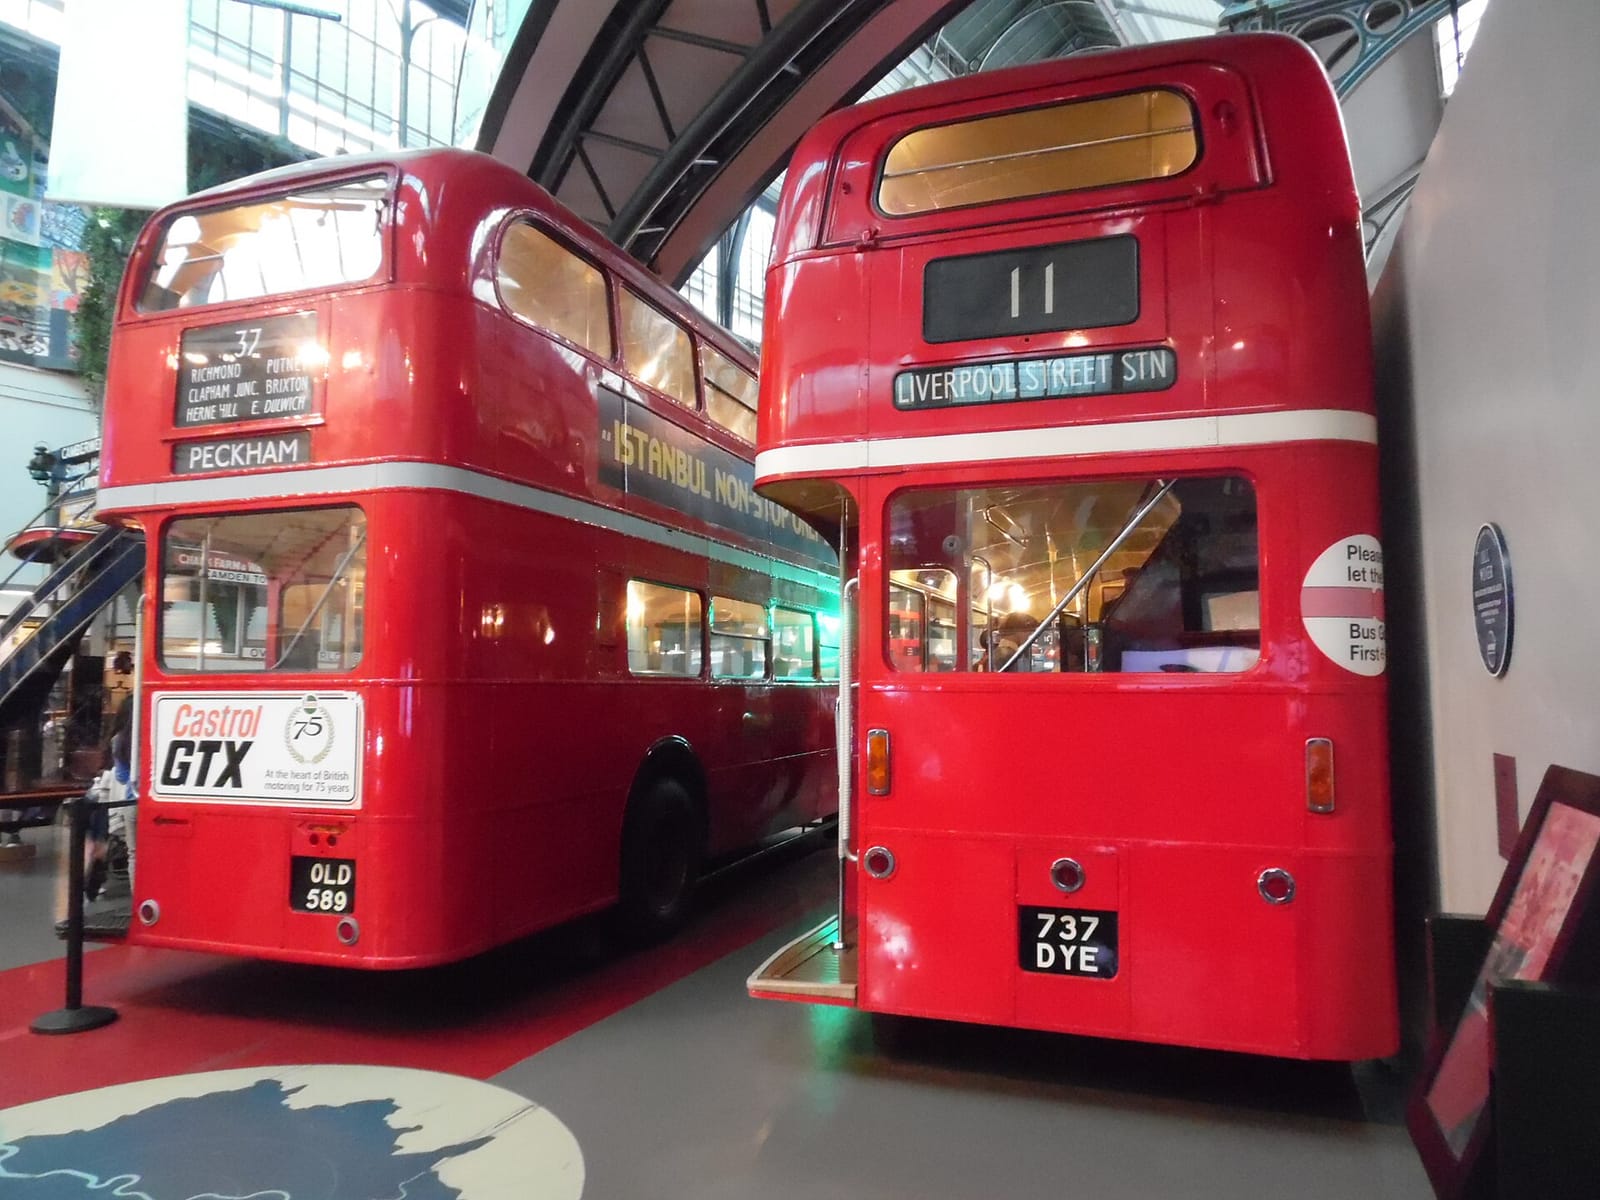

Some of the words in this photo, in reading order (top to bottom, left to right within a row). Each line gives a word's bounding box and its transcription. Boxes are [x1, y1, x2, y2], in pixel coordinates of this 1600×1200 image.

[1011, 262, 1054, 318] 11
[235, 328, 262, 358] 37
[191, 363, 242, 383] RICHMOND
[266, 356, 308, 374] PUTNE
[898, 363, 1017, 404] LIVERPOOL
[1025, 353, 1114, 392] STREET
[1121, 350, 1167, 382] STN
[188, 384, 230, 403] CLAPHAM
[265, 375, 309, 394] BRIXTON
[186, 404, 217, 422] HERNE
[219, 403, 238, 418] HILL
[263, 396, 306, 414] DULWICH
[189, 438, 298, 469] PECKHAM
[1348, 566, 1367, 582] let
[1350, 623, 1376, 640] Bus
[1350, 645, 1380, 661] First
[172, 703, 263, 739] Castrol
[294, 716, 322, 740] 75
[161, 740, 254, 788] GTX
[265, 770, 273, 778] At
[275, 769, 288, 779] the
[290, 770, 311, 780] heart
[313, 770, 321, 780] of
[323, 770, 349, 781] British
[264, 782, 300, 793] motoring
[302, 781, 313, 791] for
[315, 782, 325, 792] 75
[327, 784, 350, 794] years
[311, 863, 351, 885] OLD
[305, 889, 347, 912] 589
[1037, 913, 1099, 941] 737
[1036, 942, 1098, 972] DYE
